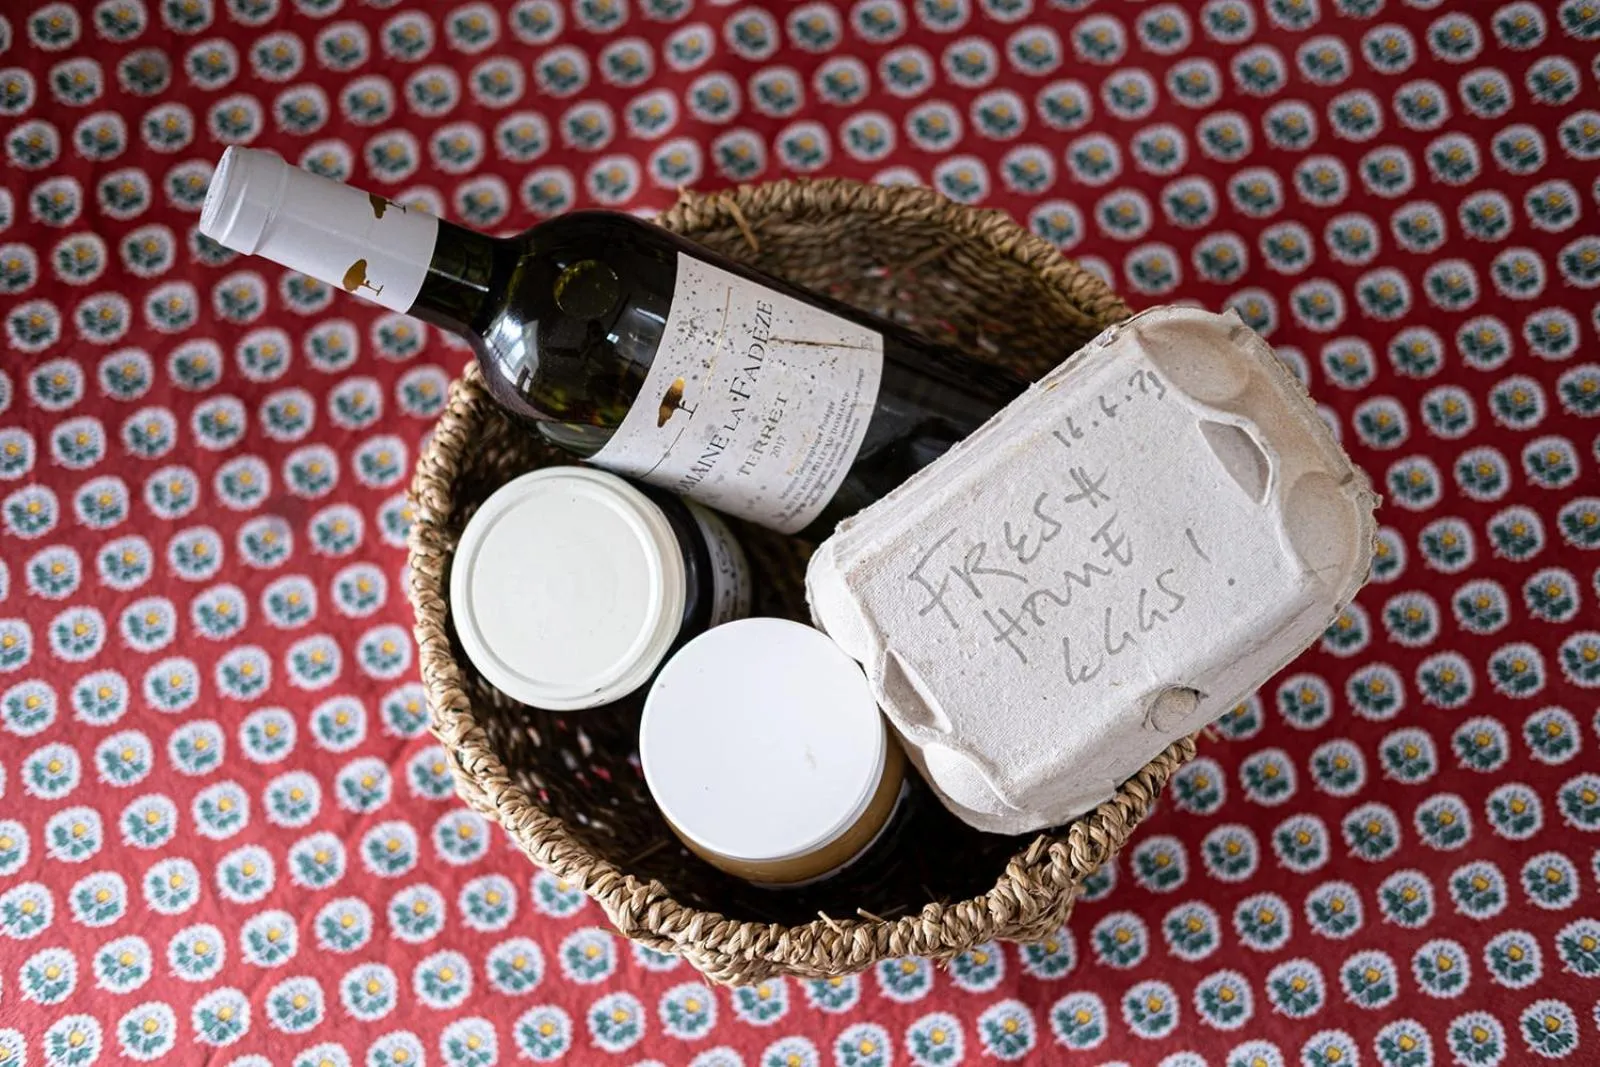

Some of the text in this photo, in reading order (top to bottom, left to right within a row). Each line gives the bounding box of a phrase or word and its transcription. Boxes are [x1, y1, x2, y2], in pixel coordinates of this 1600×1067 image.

[670, 433, 730, 493] OMAINE
[723, 407, 746, 431] LA
[738, 391, 788, 476] TERRET
[830, 391, 850, 435] DOMAINE
[907, 464, 1110, 630] FRESH
